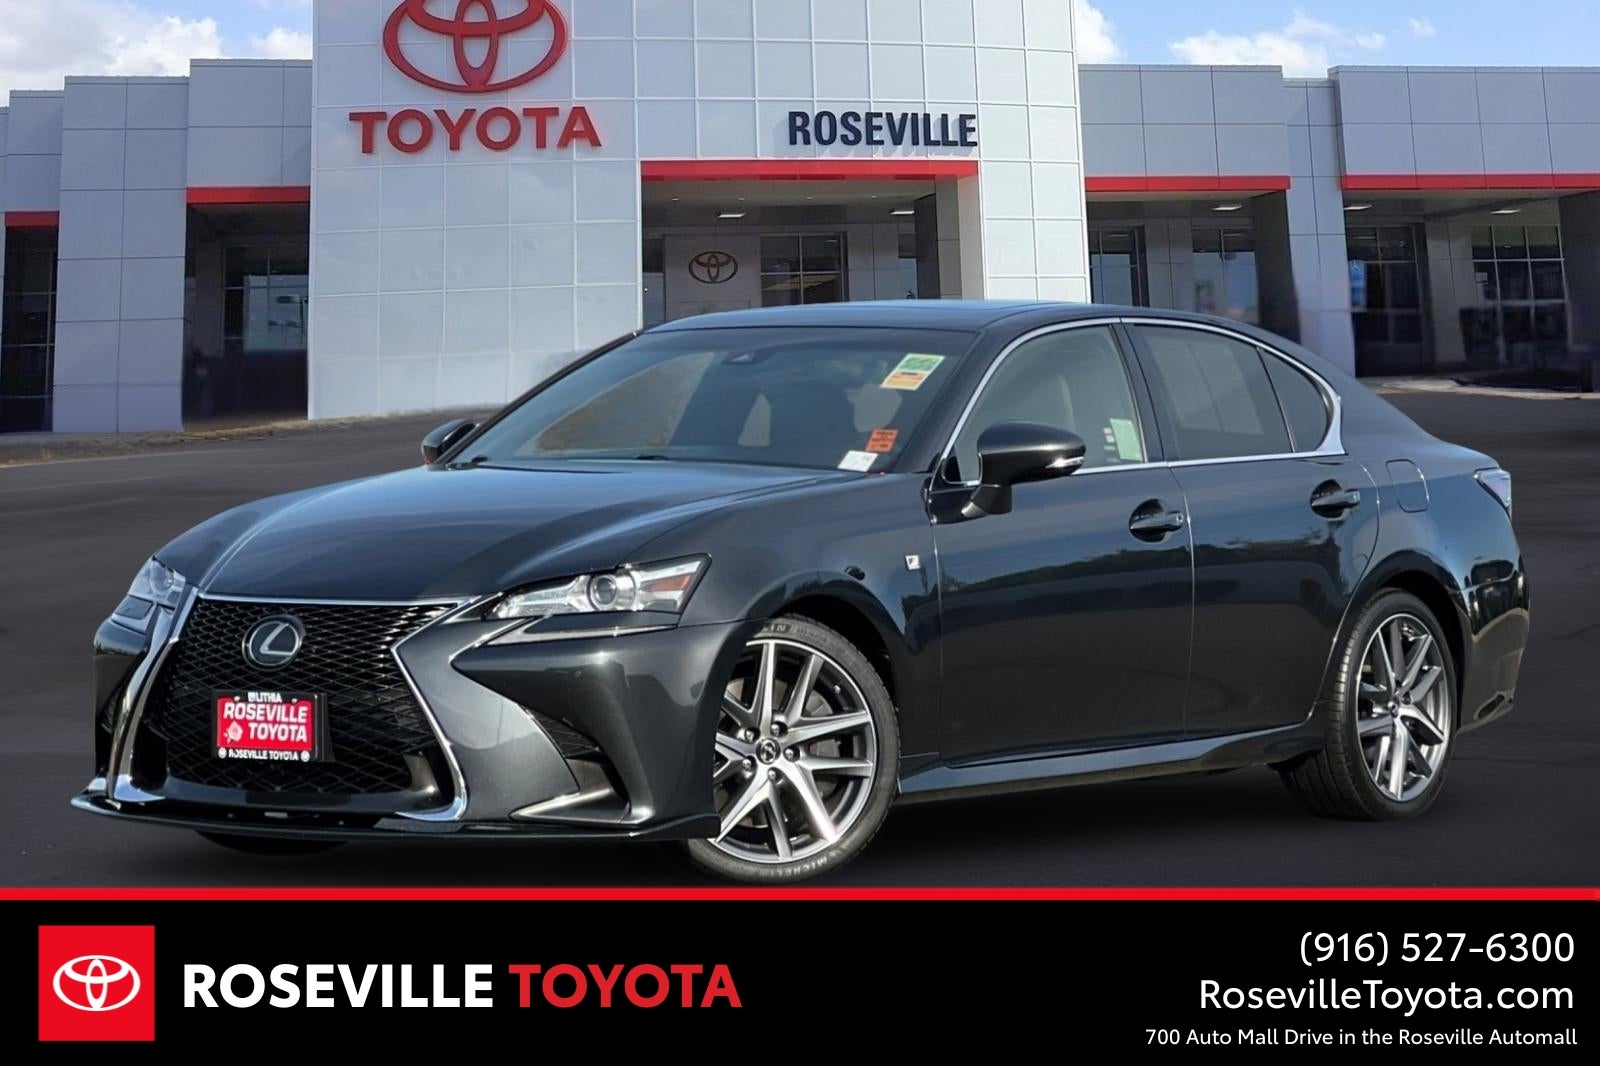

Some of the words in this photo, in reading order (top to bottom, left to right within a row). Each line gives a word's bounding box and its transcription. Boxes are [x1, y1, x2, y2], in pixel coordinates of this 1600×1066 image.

[350, 106, 602, 153] TOYOTA
[789, 111, 978, 147] ROSEVILLE
[223, 702, 308, 723] ROSEVILLE
[248, 722, 307, 742] TOYOTA
